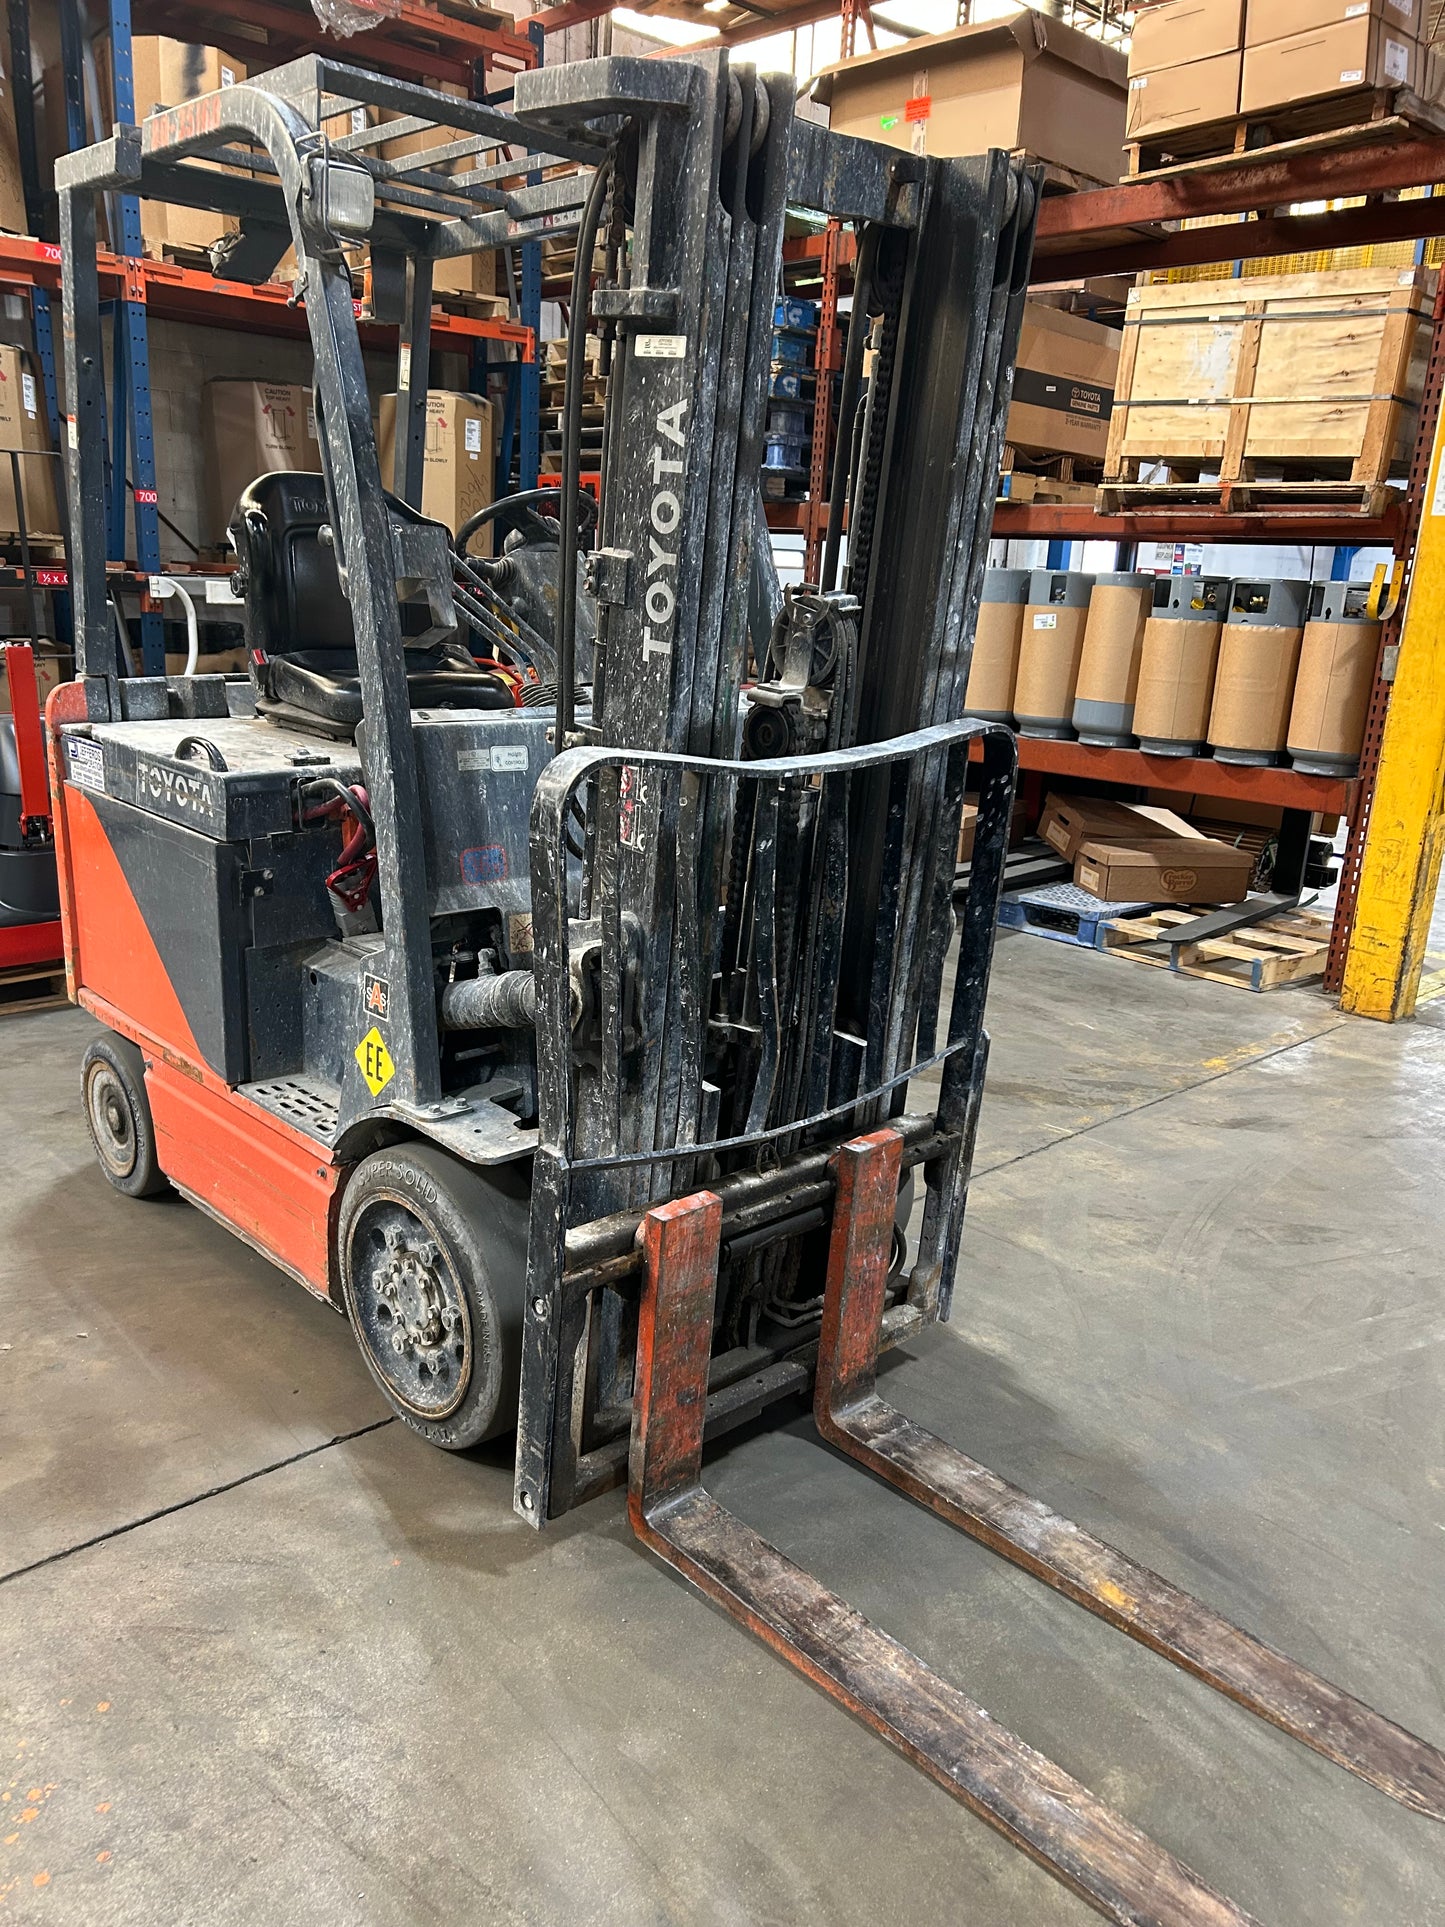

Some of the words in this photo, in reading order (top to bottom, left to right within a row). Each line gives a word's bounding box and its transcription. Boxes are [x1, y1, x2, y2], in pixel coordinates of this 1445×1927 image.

[264, 388, 291, 396] CAUTION
[1080, 389, 1101, 402] TOYOTA
[139, 491, 158, 502] 700
[642, 398, 688, 664] TOYOTA
[138, 762, 214, 817] TOYOTA
[366, 1042, 383, 1082] EE
[358, 1160, 393, 1187] SUPER
[396, 1163, 438, 1204] SOLID
